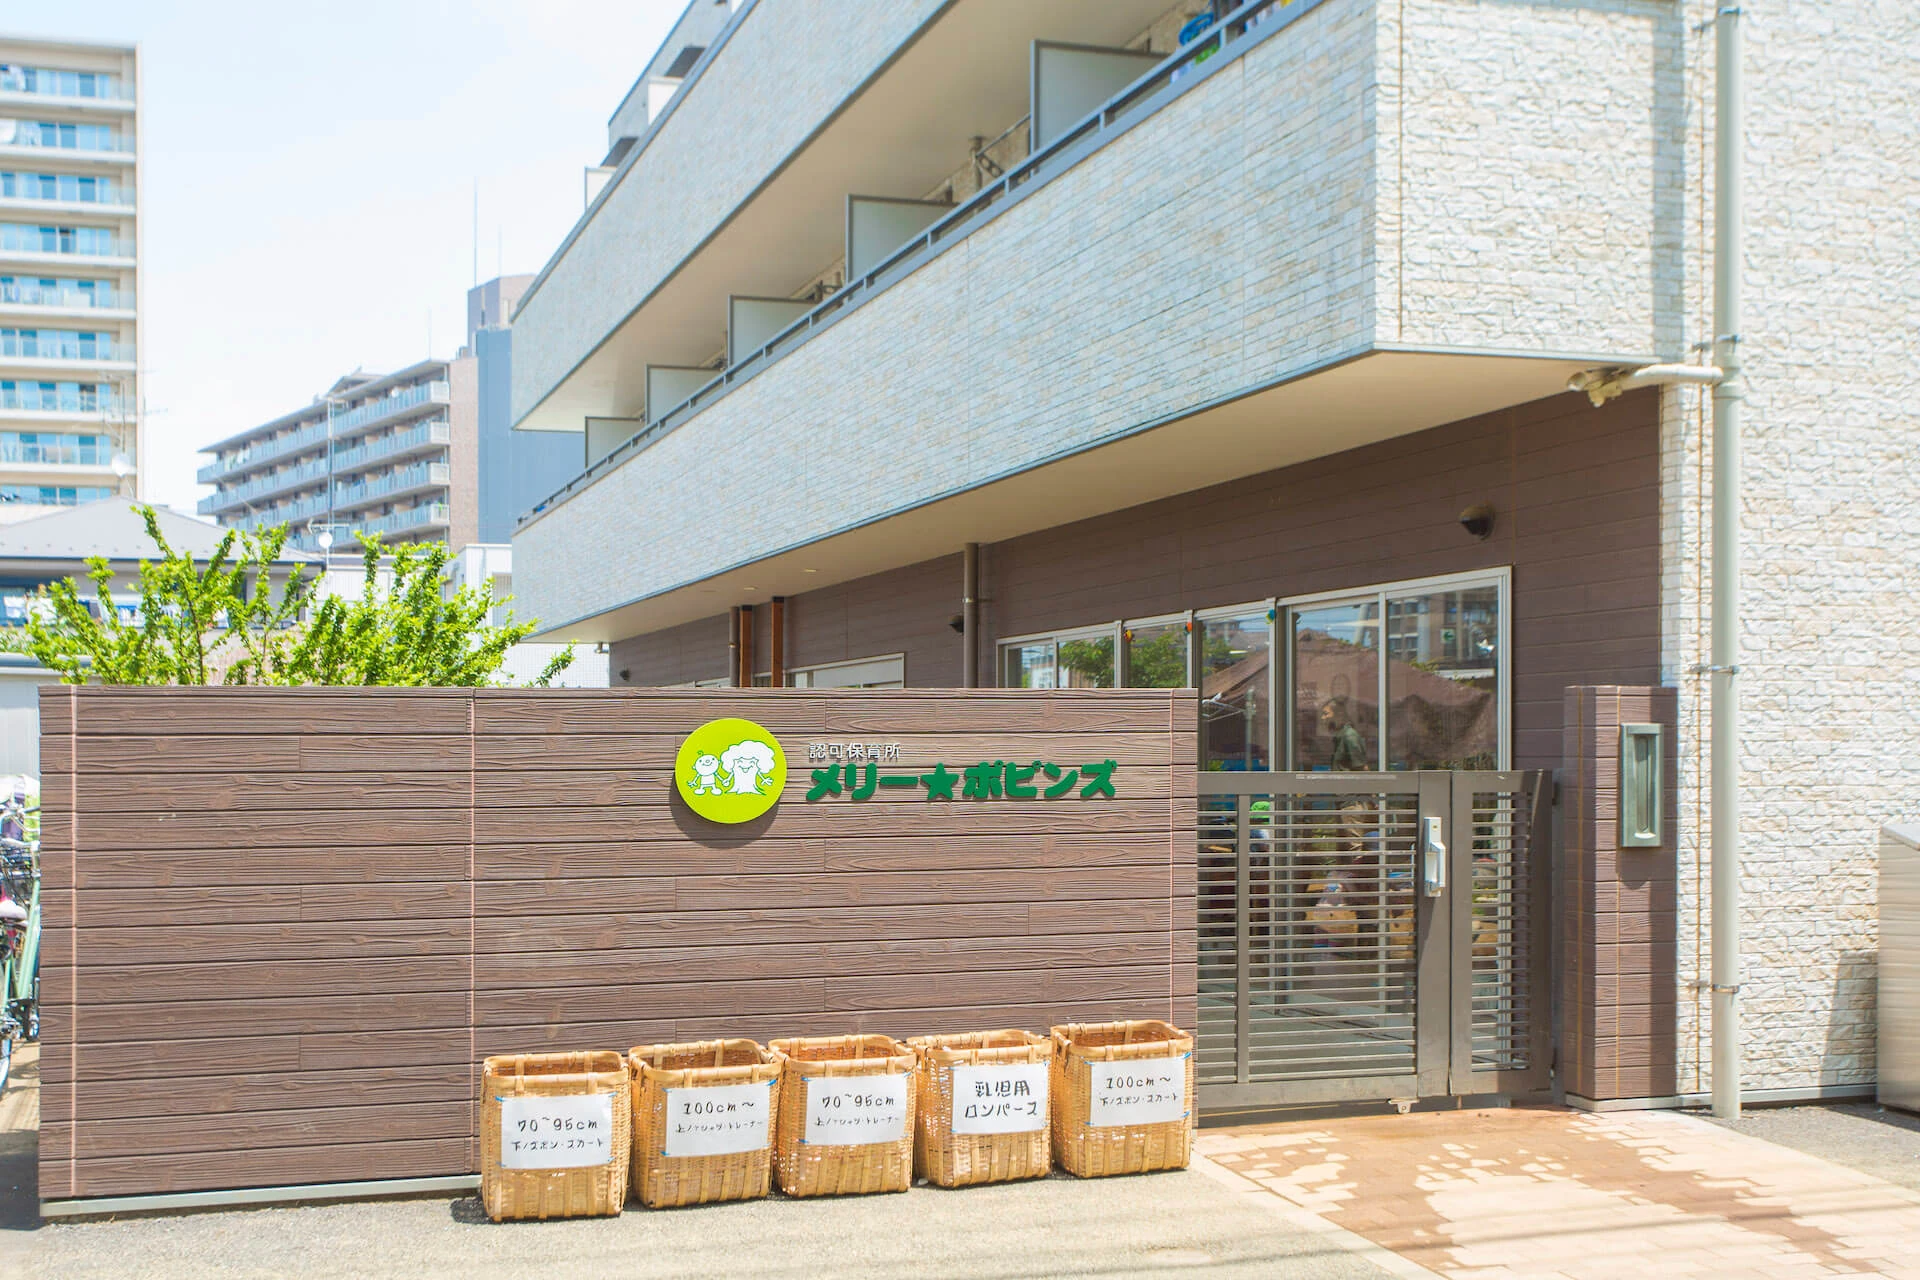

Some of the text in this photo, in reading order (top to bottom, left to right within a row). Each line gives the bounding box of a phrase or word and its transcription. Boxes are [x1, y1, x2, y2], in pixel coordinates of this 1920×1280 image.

[808, 742, 901, 760] 認可保育所
[974, 1080, 1031, 1098] 乳児用
[964, 1100, 1038, 1119] ロンパース
